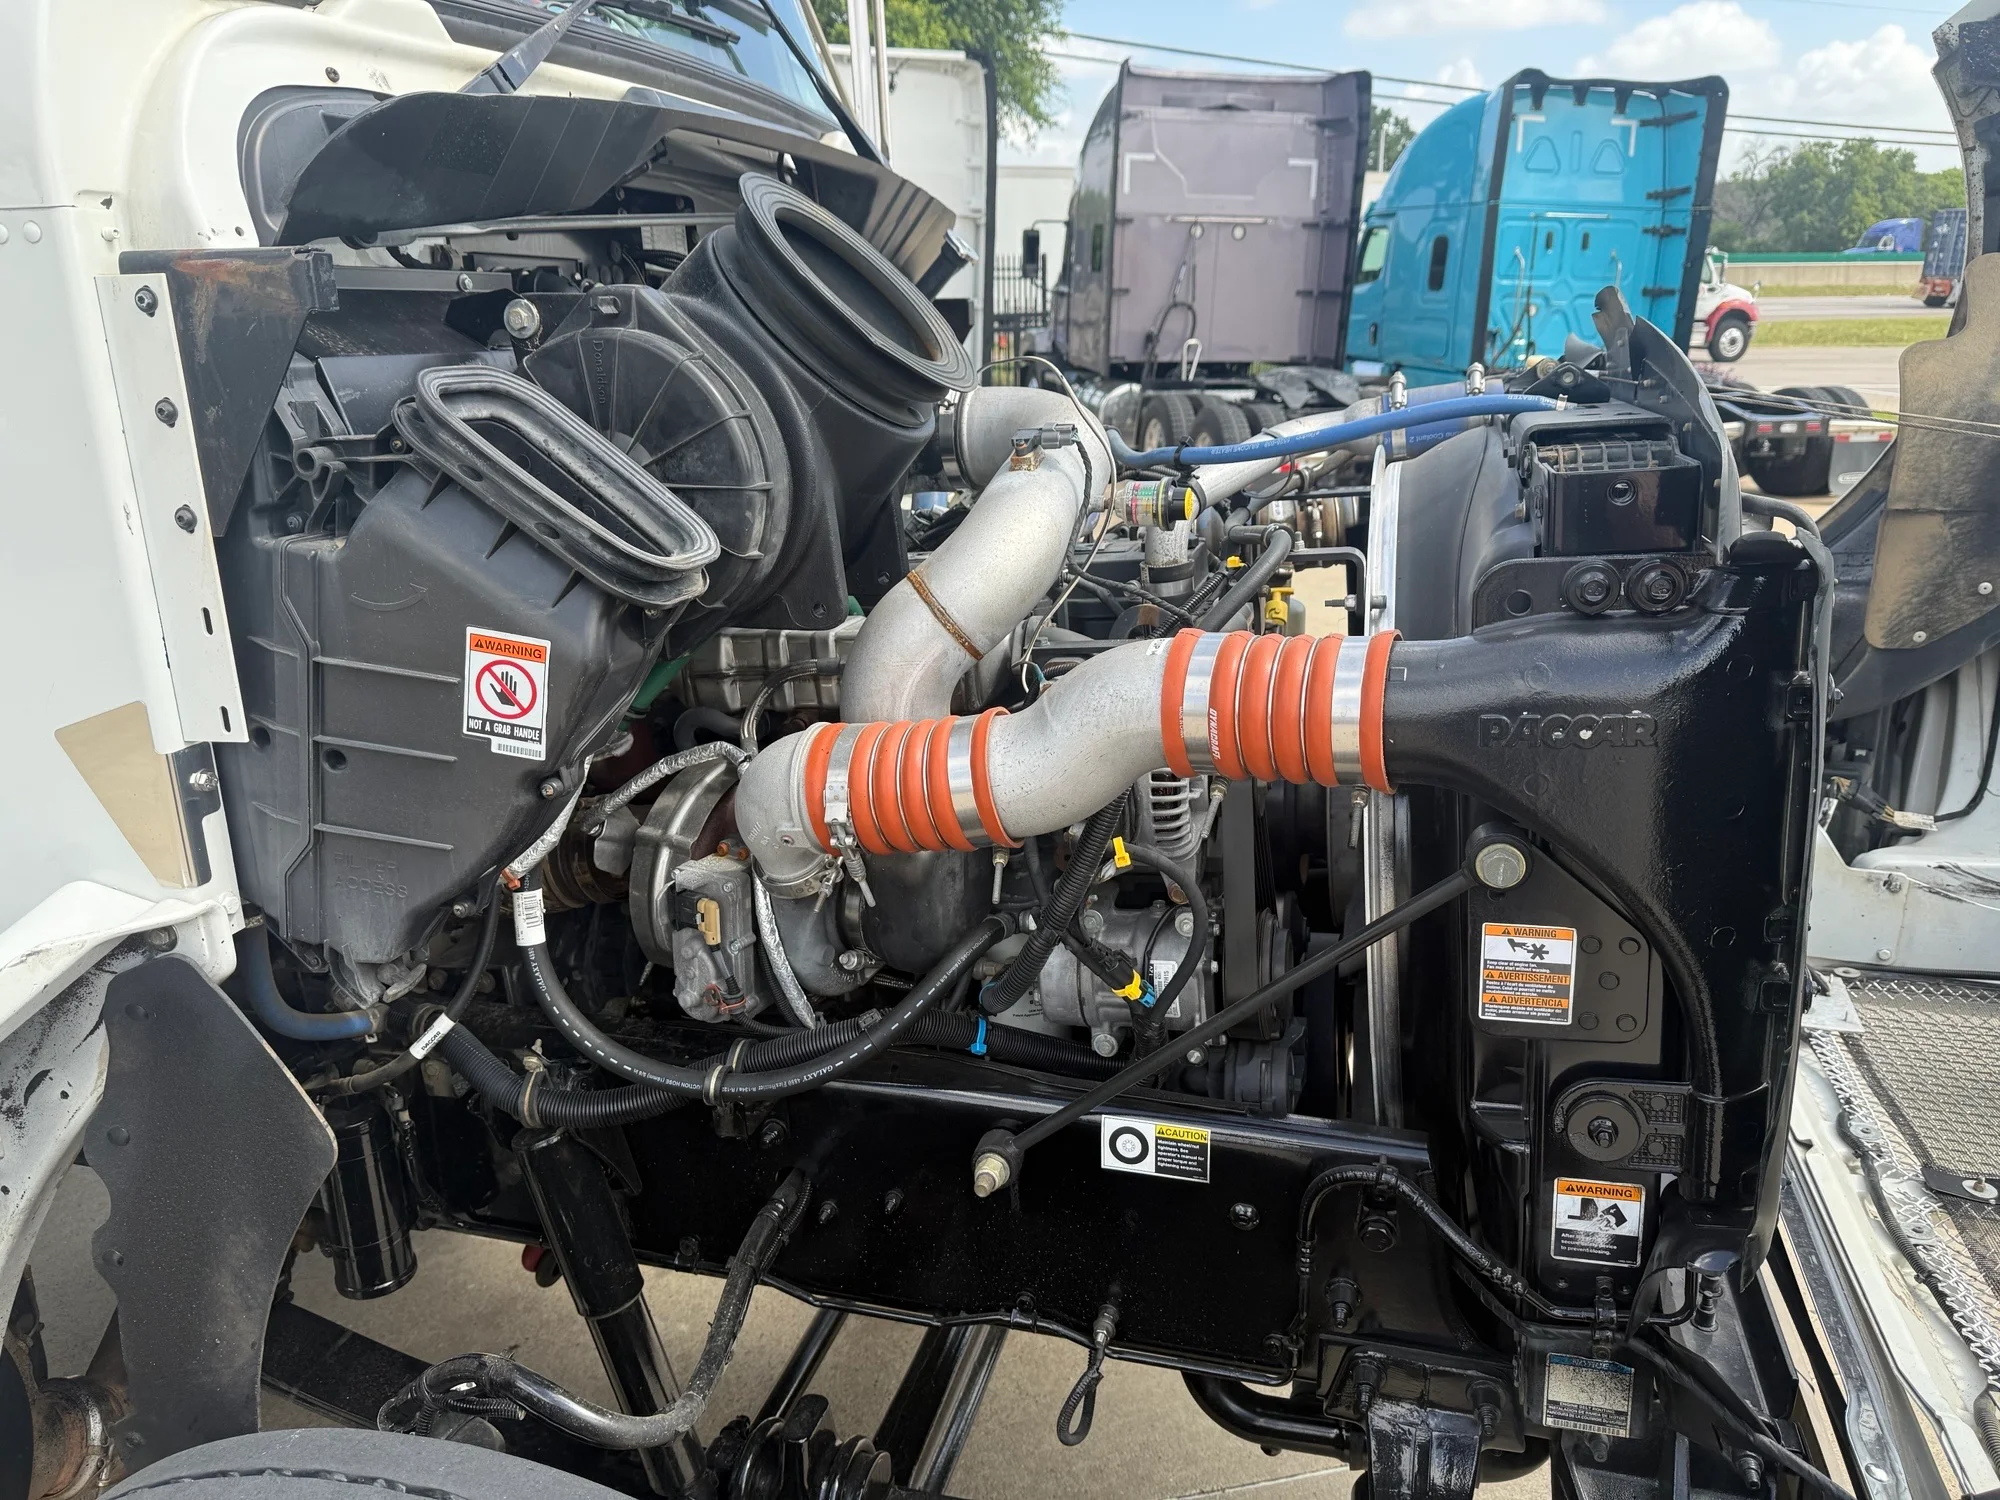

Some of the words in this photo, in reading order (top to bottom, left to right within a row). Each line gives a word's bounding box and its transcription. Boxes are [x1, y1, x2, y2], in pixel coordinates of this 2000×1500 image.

[593, 340, 607, 404] Donaldson
[1211, 447, 1233, 455] HEATER
[484, 639, 542, 659] WARNING
[468, 718, 483, 730] NOT
[484, 721, 491, 732] A
[493, 723, 511, 735] GRAB
[513, 726, 540, 740] HANDLE
[1209, 707, 1221, 760] DYNACRAFT
[1479, 713, 1658, 750] PACCAR
[334, 874, 408, 898] ACCESS
[1513, 928, 1557, 938] WARNING
[960, 948, 974, 962] HOSE
[530, 961, 547, 991] GALAXY
[1498, 972, 1569, 984] AVERTISSEMENT
[1501, 995, 1563, 1007] ADVERTENCIA
[421, 1030, 441, 1051] PACCAR
[802, 1065, 833, 1083] GALAXY
[681, 1082, 703, 1090] UCTION
[1165, 1128, 1207, 1141] CAUTION
[1157, 1161, 1179, 1169] tightening
[1575, 1184, 1633, 1198] WARNING
[1599, 1242, 1617, 1250] device
